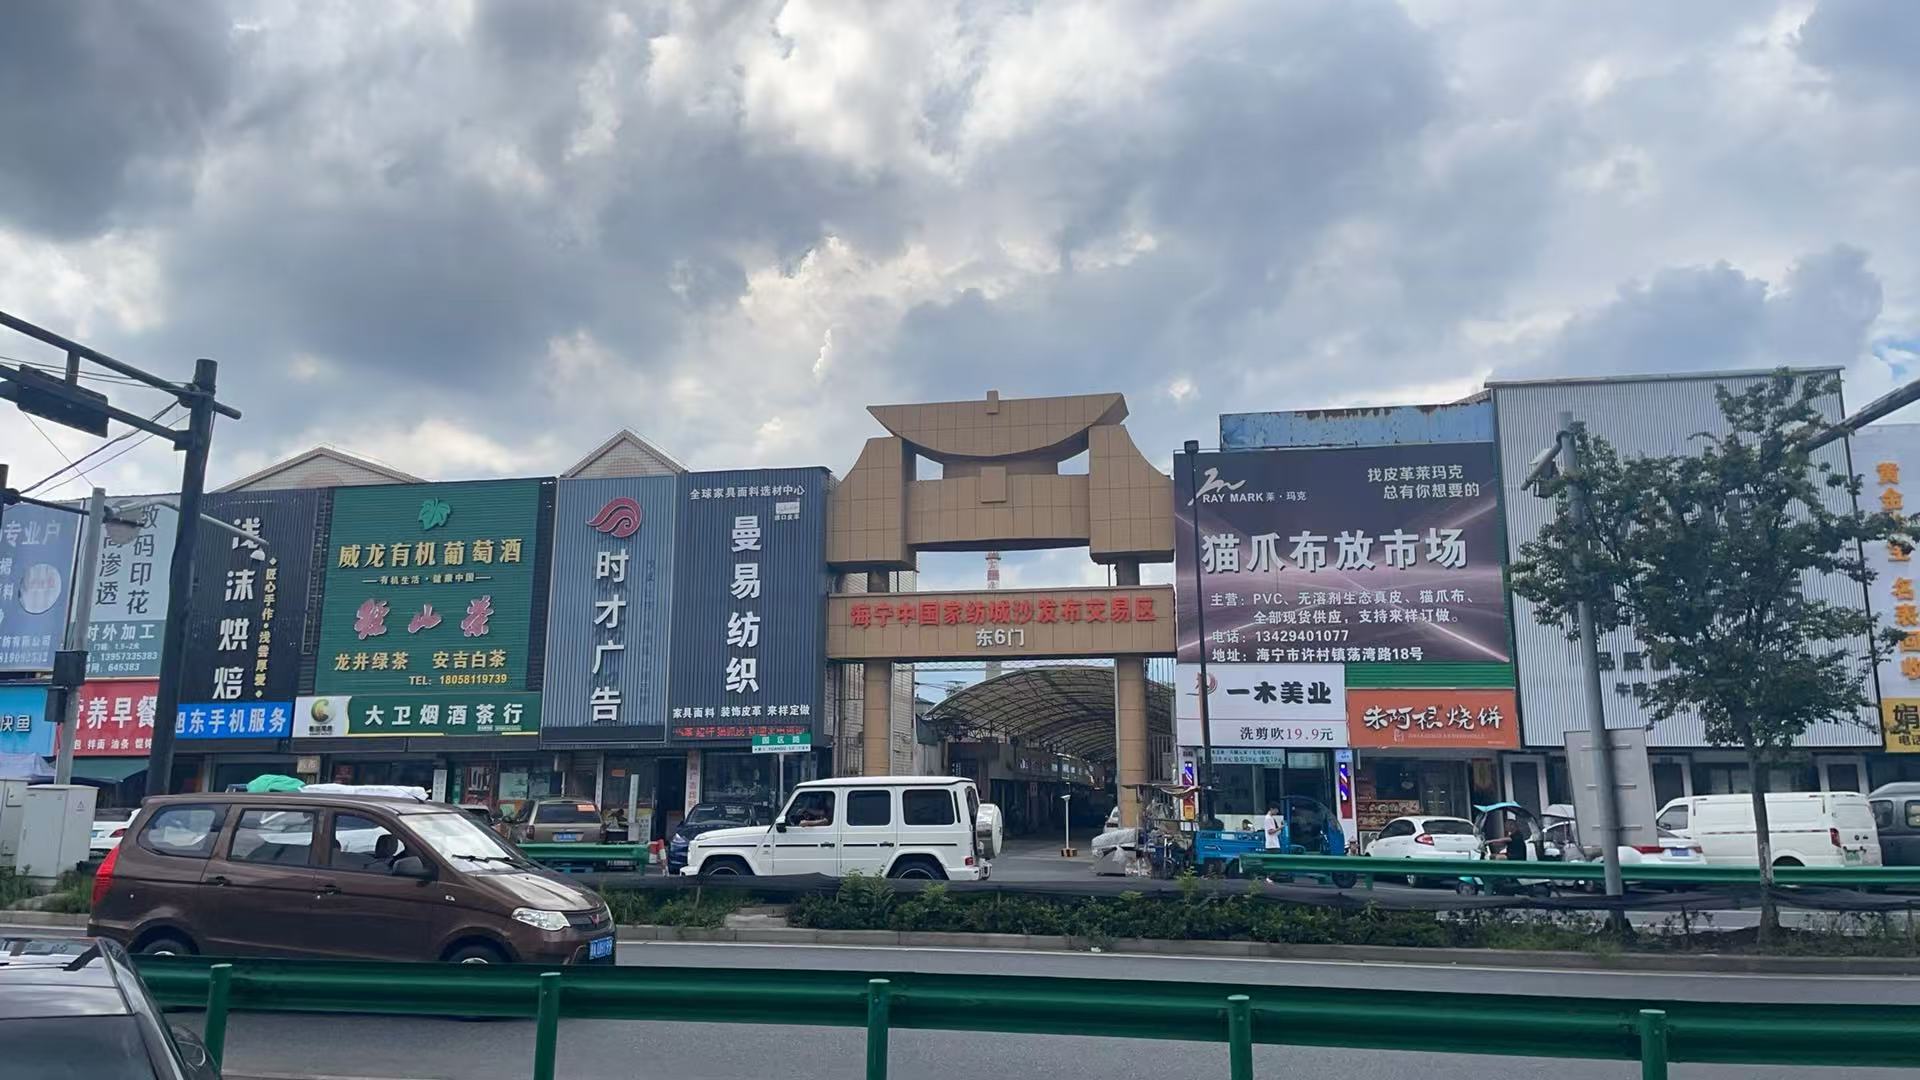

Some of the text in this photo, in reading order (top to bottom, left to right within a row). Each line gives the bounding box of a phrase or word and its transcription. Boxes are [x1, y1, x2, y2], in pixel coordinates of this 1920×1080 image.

[1367, 464, 1463, 482] 找皮革莱玛克
[689, 484, 805, 500] 全球家具面料选材中心
[1202, 493, 1225, 503] RAY
[1230, 492, 1264, 503] MARK
[1383, 482, 1480, 499] 总有你想要的
[338, 538, 522, 568] 威龙有机葡萄酒
[1201, 527, 1468, 574] 猫爪布放市场
[726, 515, 762, 694] 曼易纺织
[851, 597, 1156, 628] 海宁中国家纺城沙发布交易区
[590, 549, 629, 722] 时才广告
[975, 628, 1025, 648] 东6门
[334, 649, 507, 671] 龙井绿茶 安吉白茶
[439, 673, 507, 685] 18058119739
[1226, 681, 1332, 705] 一木美业
[364, 703, 524, 727] 大卫烟酒茶行
[672, 704, 810, 719] 家具面料 装饰皮革 来样定做
[1239, 724, 1334, 742] 洗剪吹19.9元
[110, 738, 129, 750] 油条
